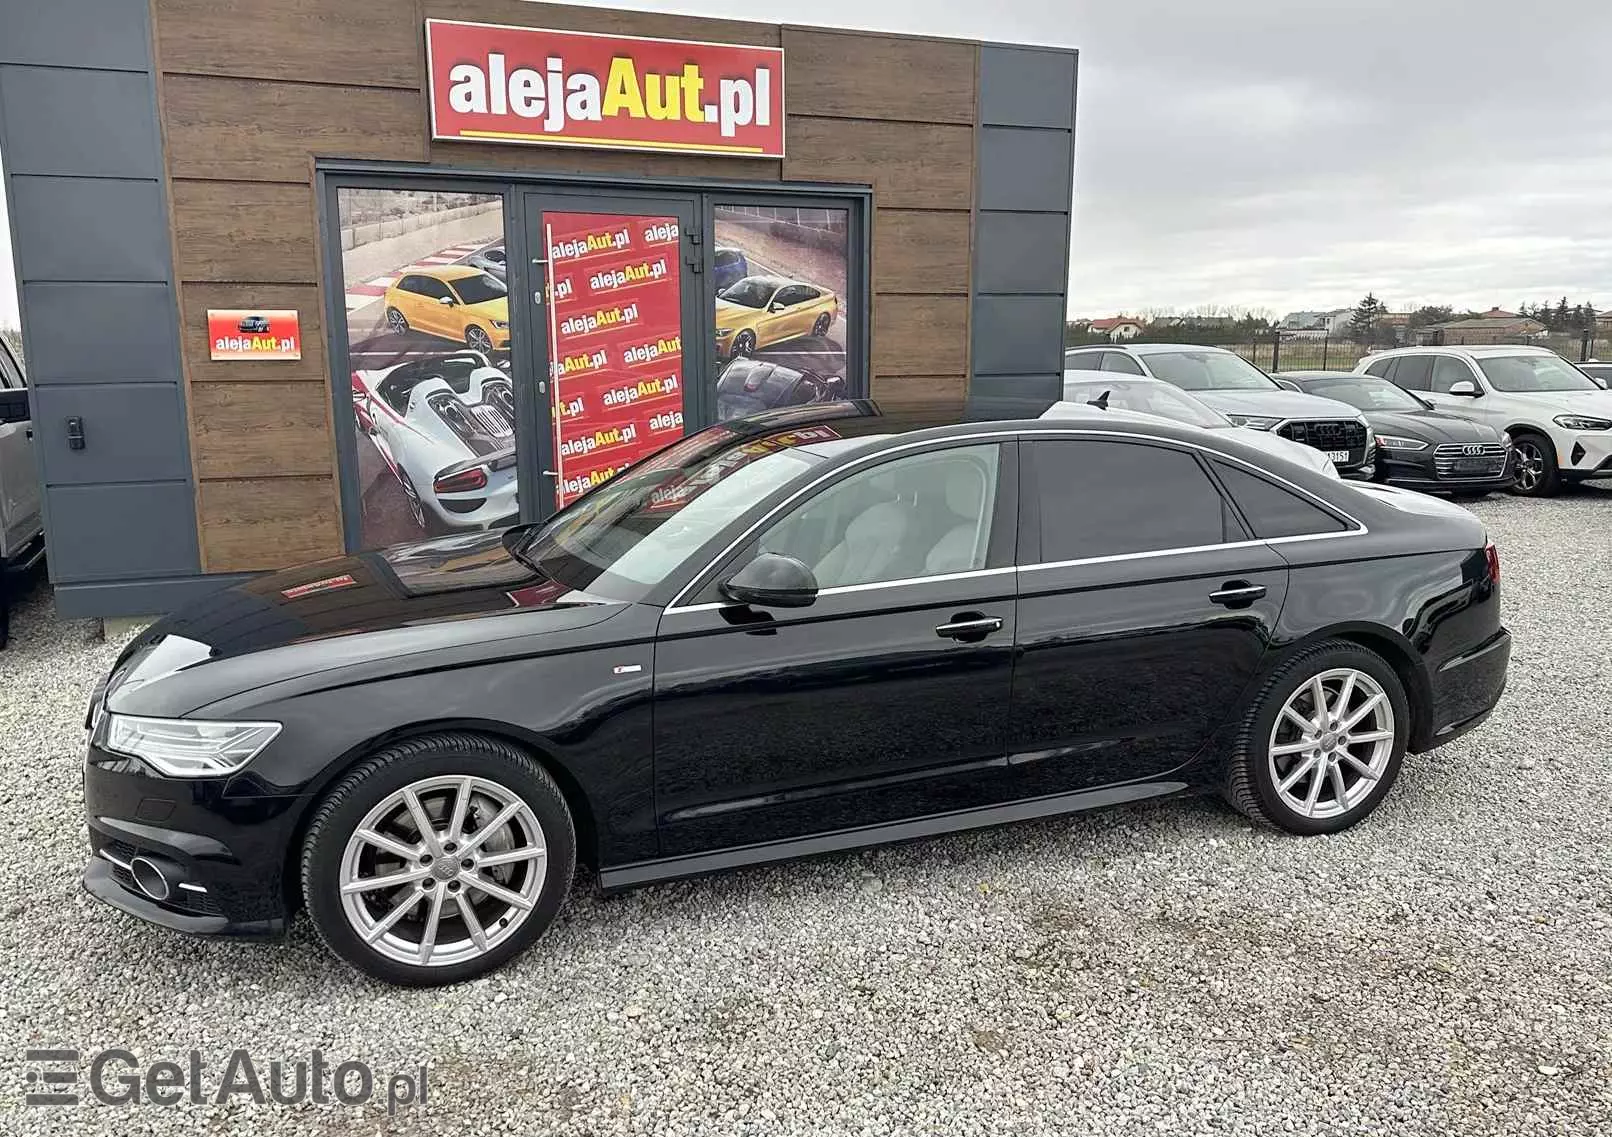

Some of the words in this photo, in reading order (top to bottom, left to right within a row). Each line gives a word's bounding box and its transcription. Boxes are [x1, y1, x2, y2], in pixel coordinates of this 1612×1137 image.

[448, 53, 771, 137] alejaAut.pl
[552, 229, 630, 259] alejaAut.pl
[645, 223, 679, 243] aleja
[590, 259, 667, 289] alejaAut.pl
[561, 304, 638, 334] alejaAut.pl
[216, 336, 295, 352] alejaAut.pl
[624, 337, 682, 363] alejaAut
[603, 375, 679, 406] alejaAut.pl
[650, 412, 683, 431] aleja
[561, 424, 637, 455] alejaAut.pl
